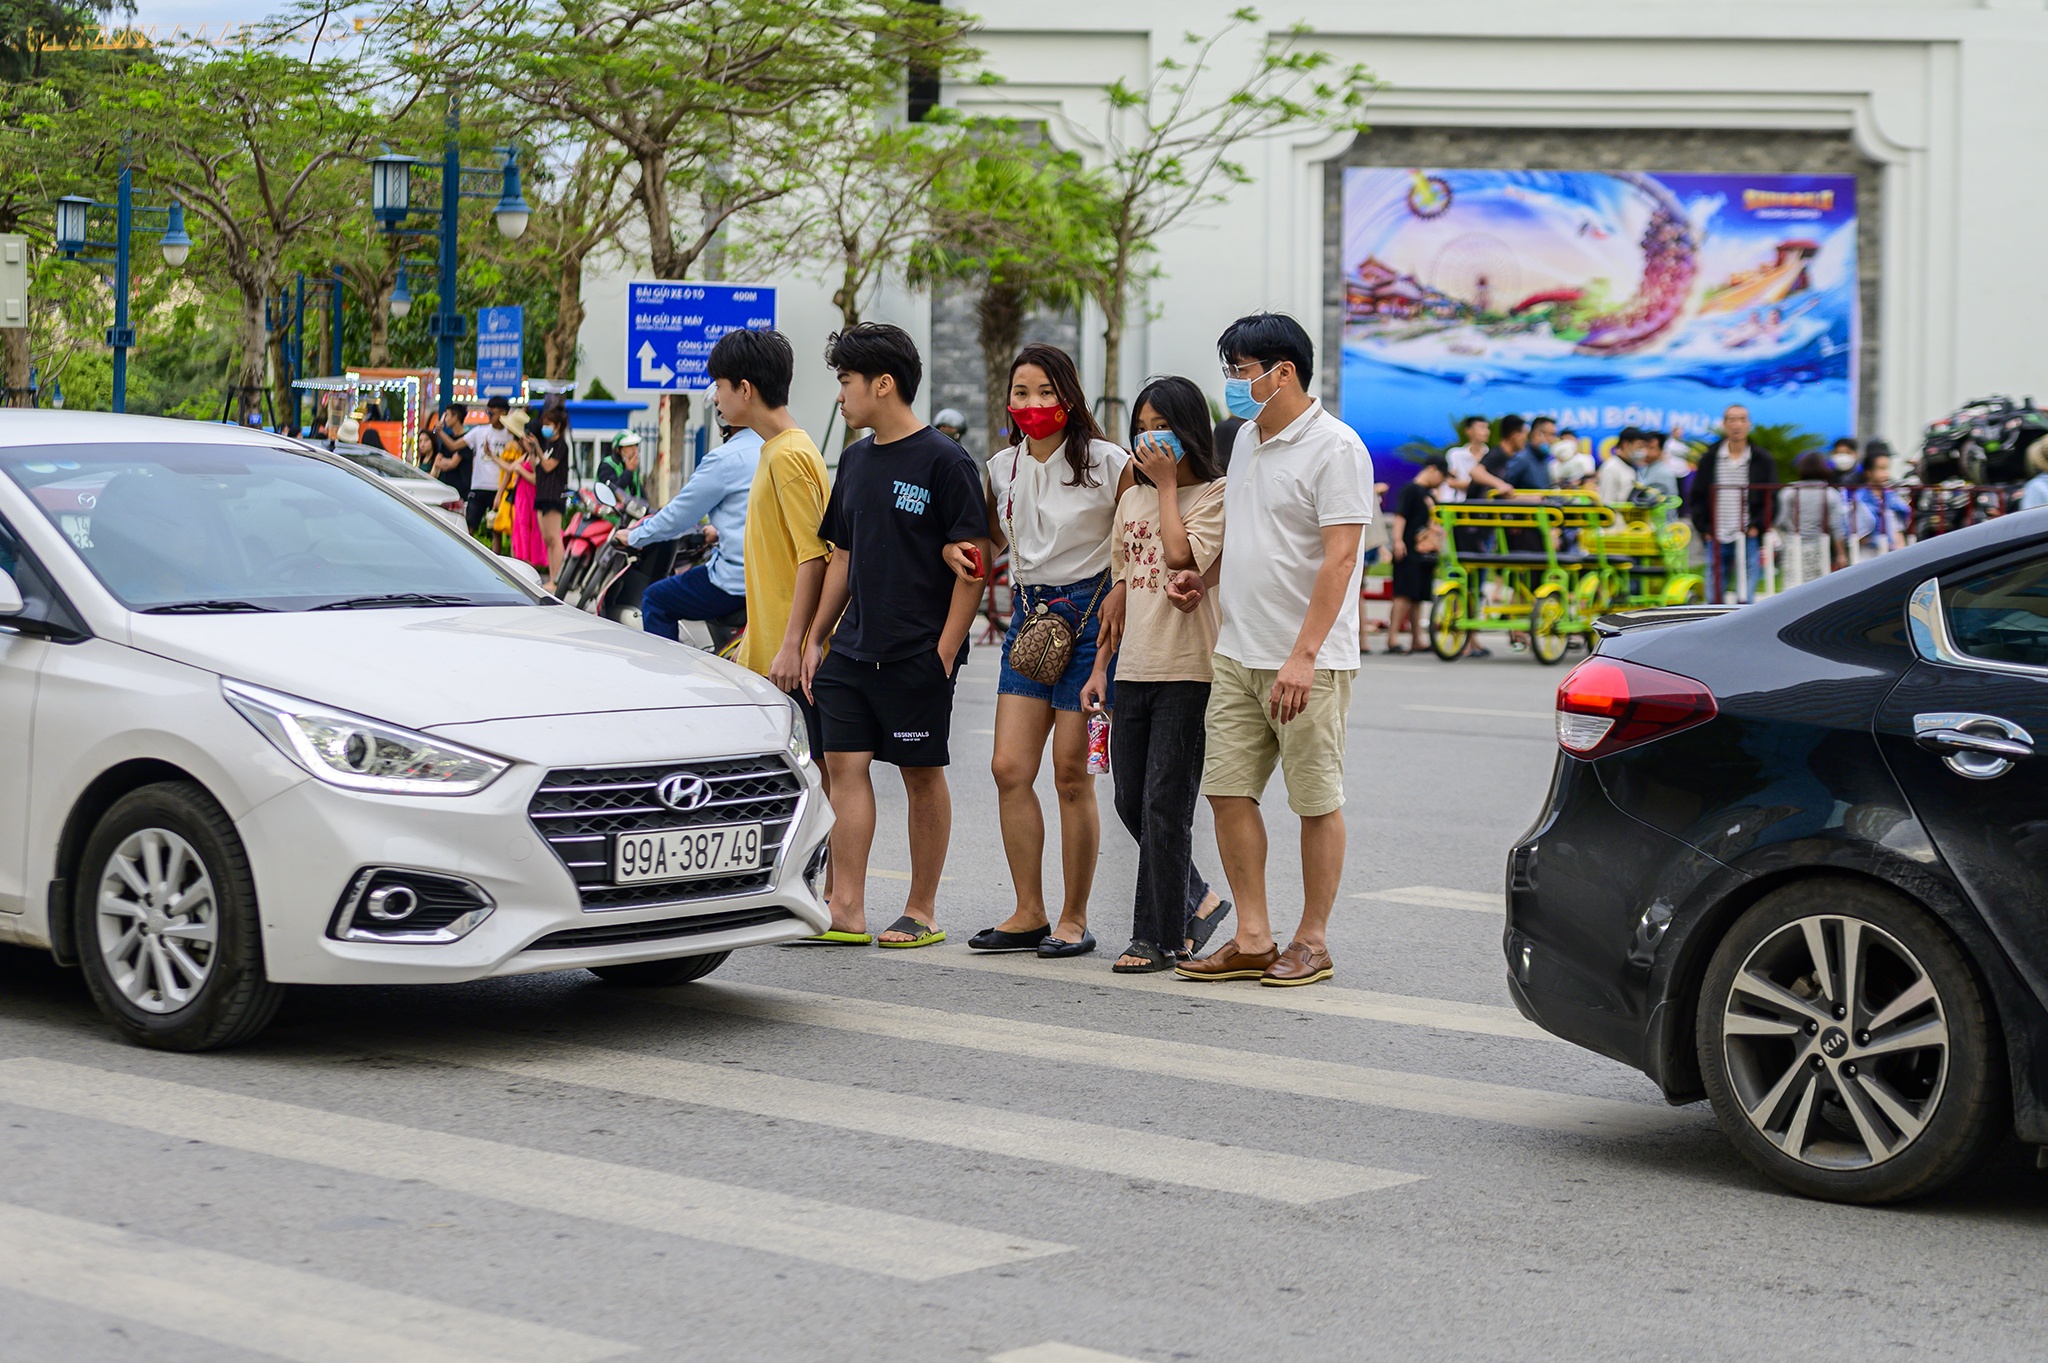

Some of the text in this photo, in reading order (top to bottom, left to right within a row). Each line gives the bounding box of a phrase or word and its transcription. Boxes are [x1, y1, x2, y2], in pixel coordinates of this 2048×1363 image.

[670, 287, 683, 300] XE
[732, 291, 758, 302] 400M
[670, 314, 683, 326] XE
[622, 828, 758, 877] 99A-387.49
